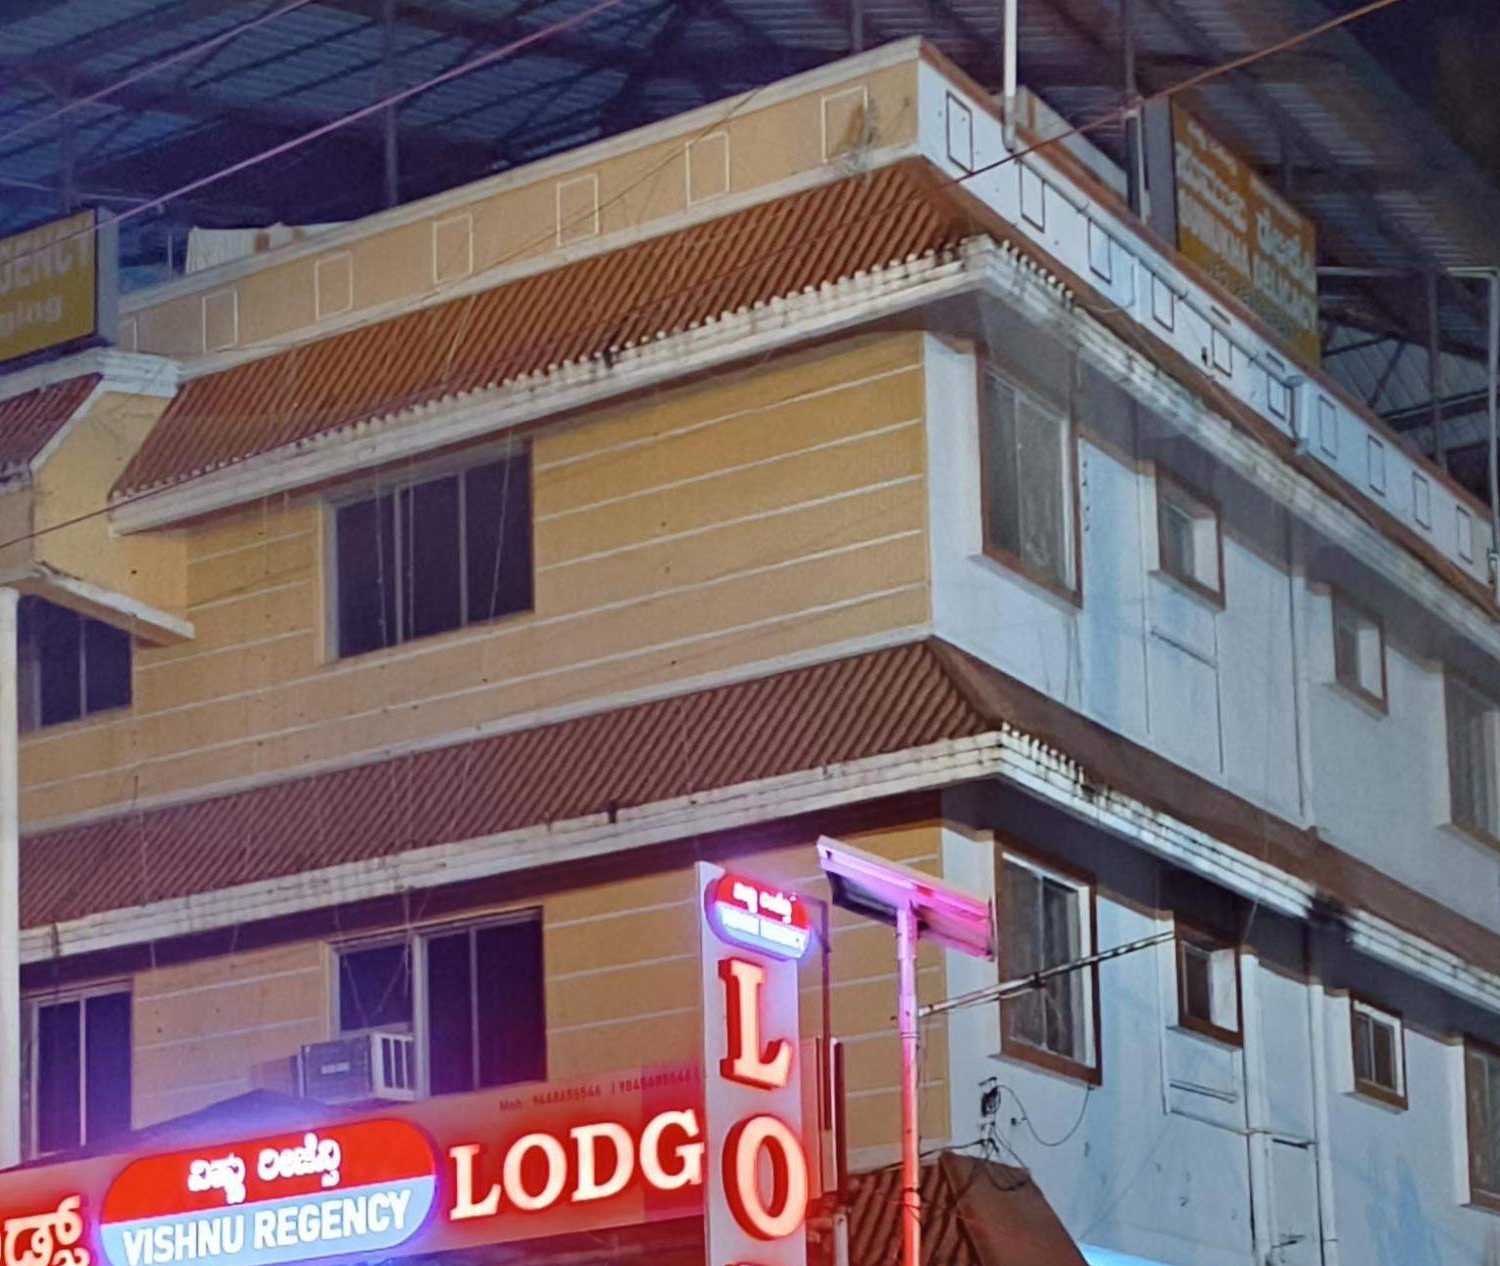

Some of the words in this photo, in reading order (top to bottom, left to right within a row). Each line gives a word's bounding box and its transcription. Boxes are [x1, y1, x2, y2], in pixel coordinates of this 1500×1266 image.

[450, 1108, 705, 1221] LODG
[122, 1214, 244, 1266] VISHNU
[254, 1189, 412, 1250] REGENCY
